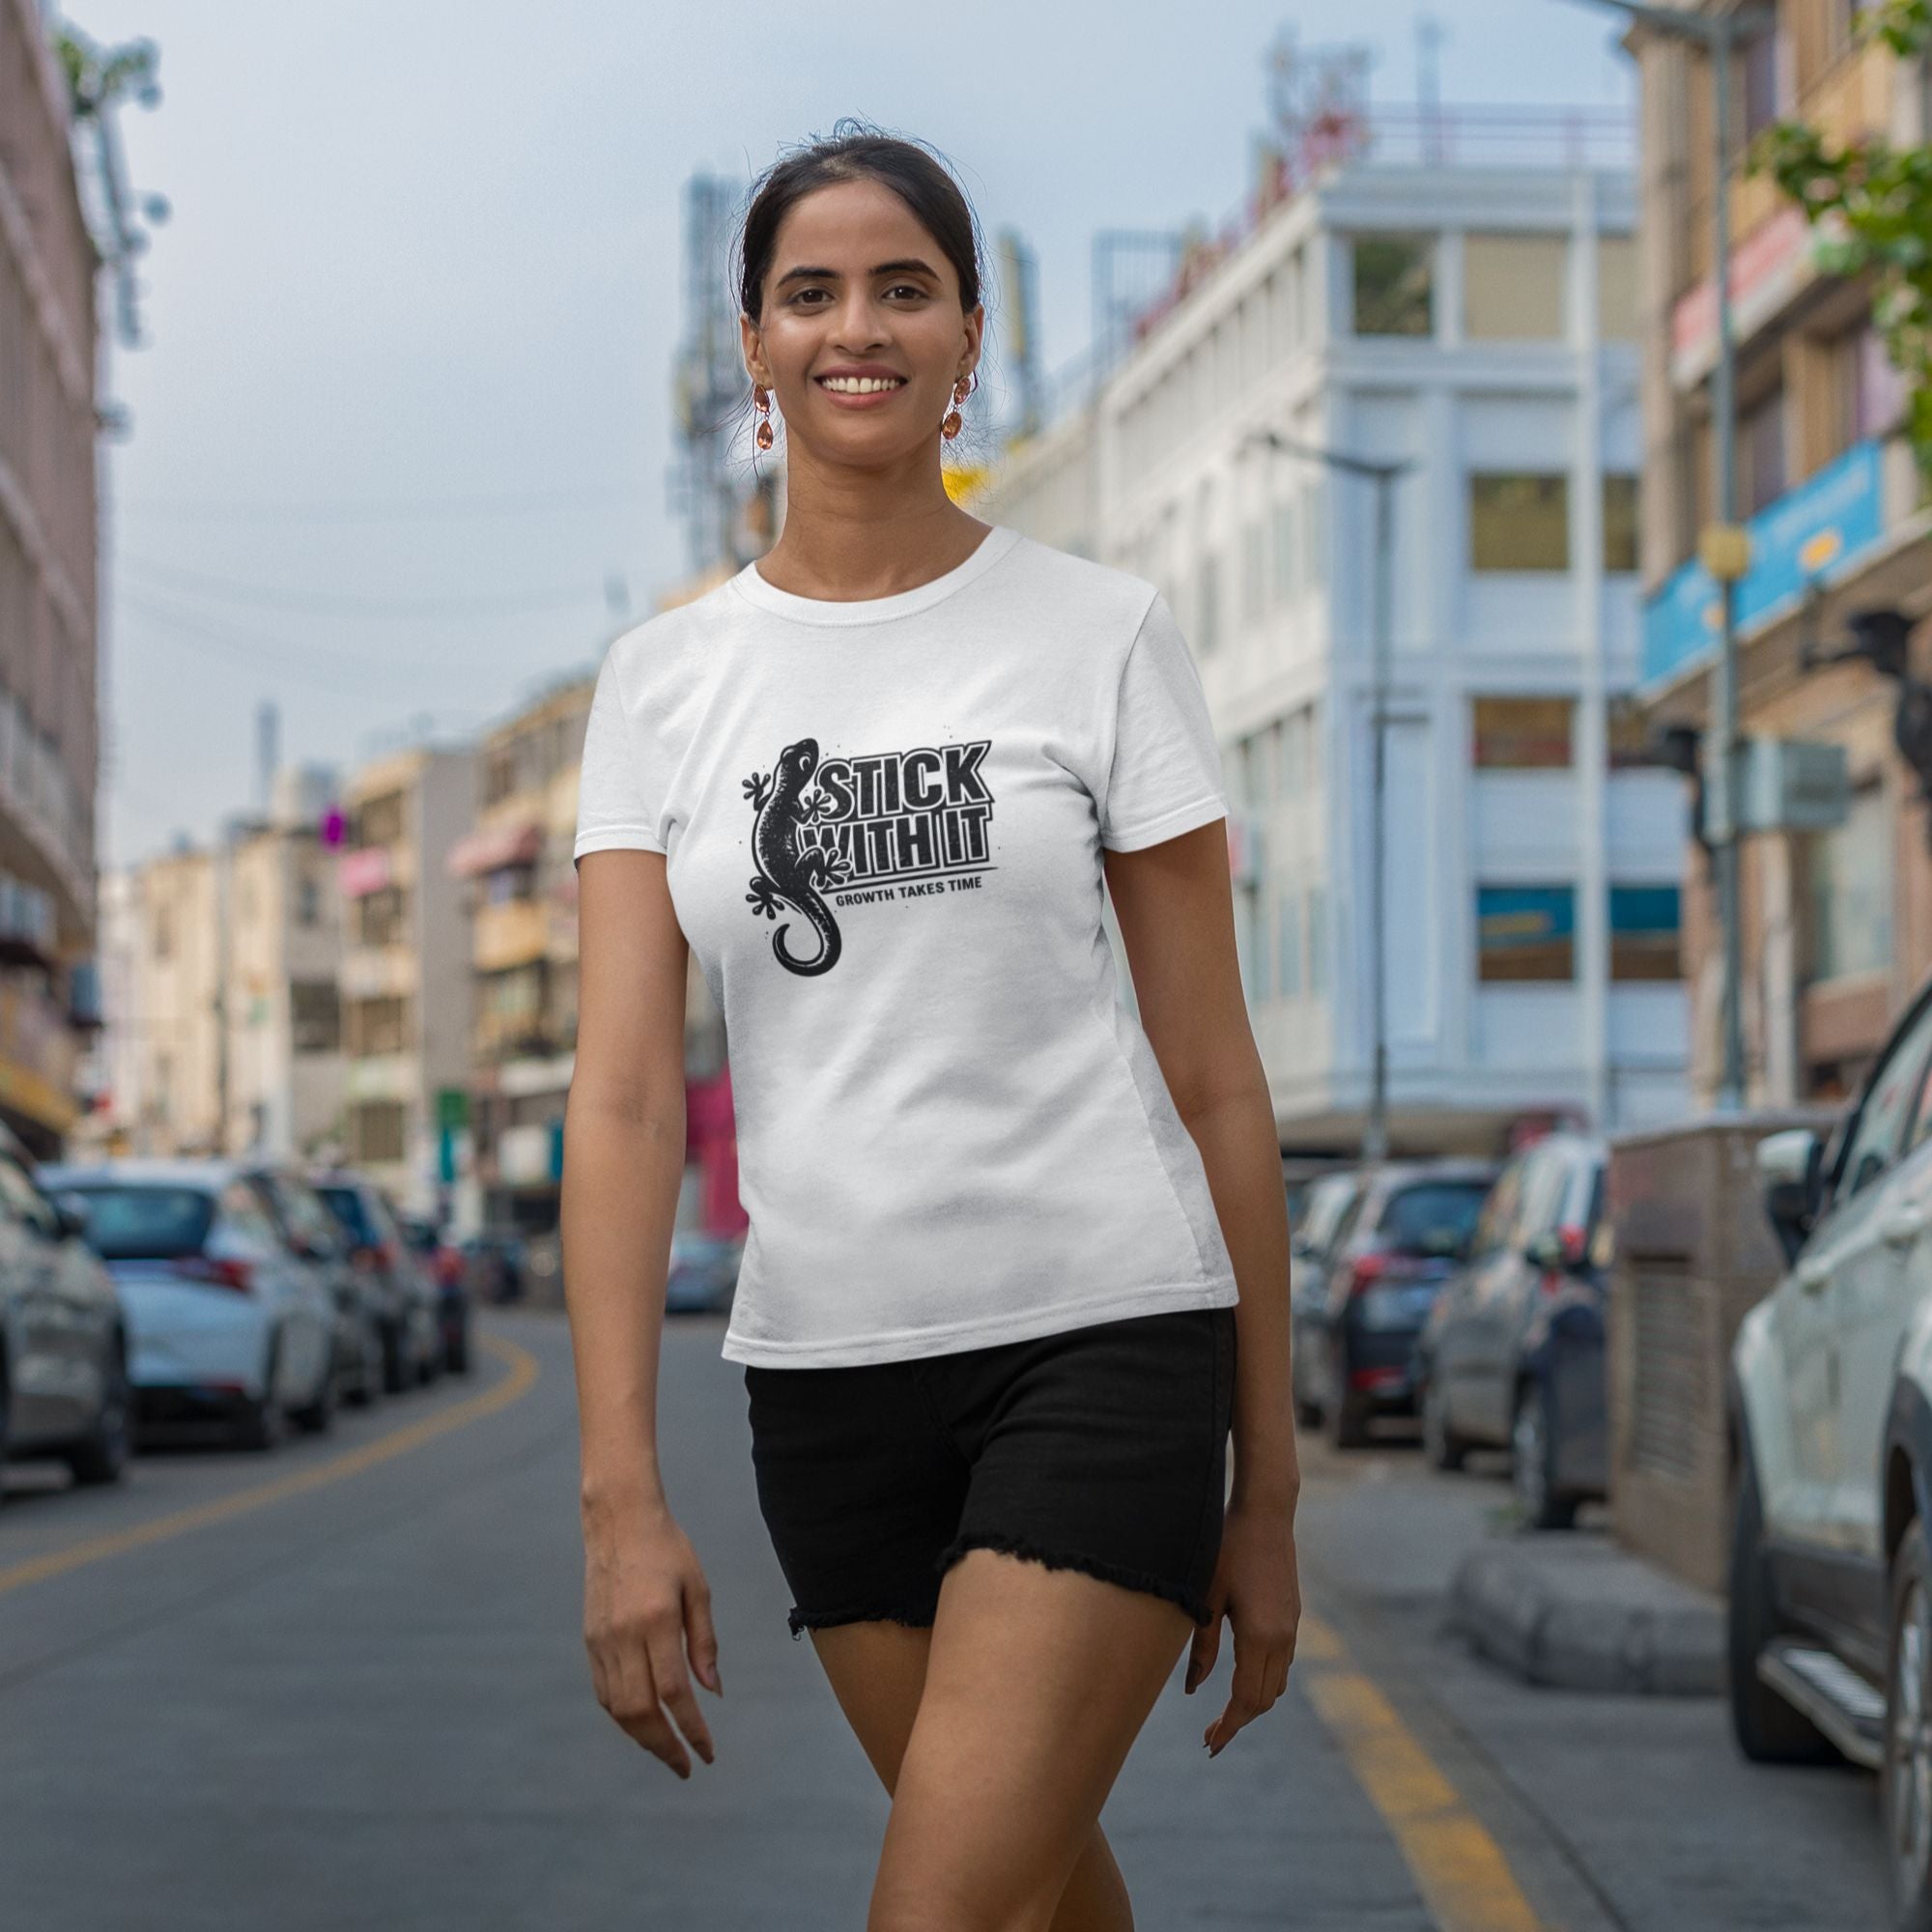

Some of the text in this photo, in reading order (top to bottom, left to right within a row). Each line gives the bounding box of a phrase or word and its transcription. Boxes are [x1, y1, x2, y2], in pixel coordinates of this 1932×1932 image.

[816, 742, 993, 820] STICK
[802, 806, 991, 876] WITH IT
[836, 876, 982, 907] GROWTH TAKES TIME
